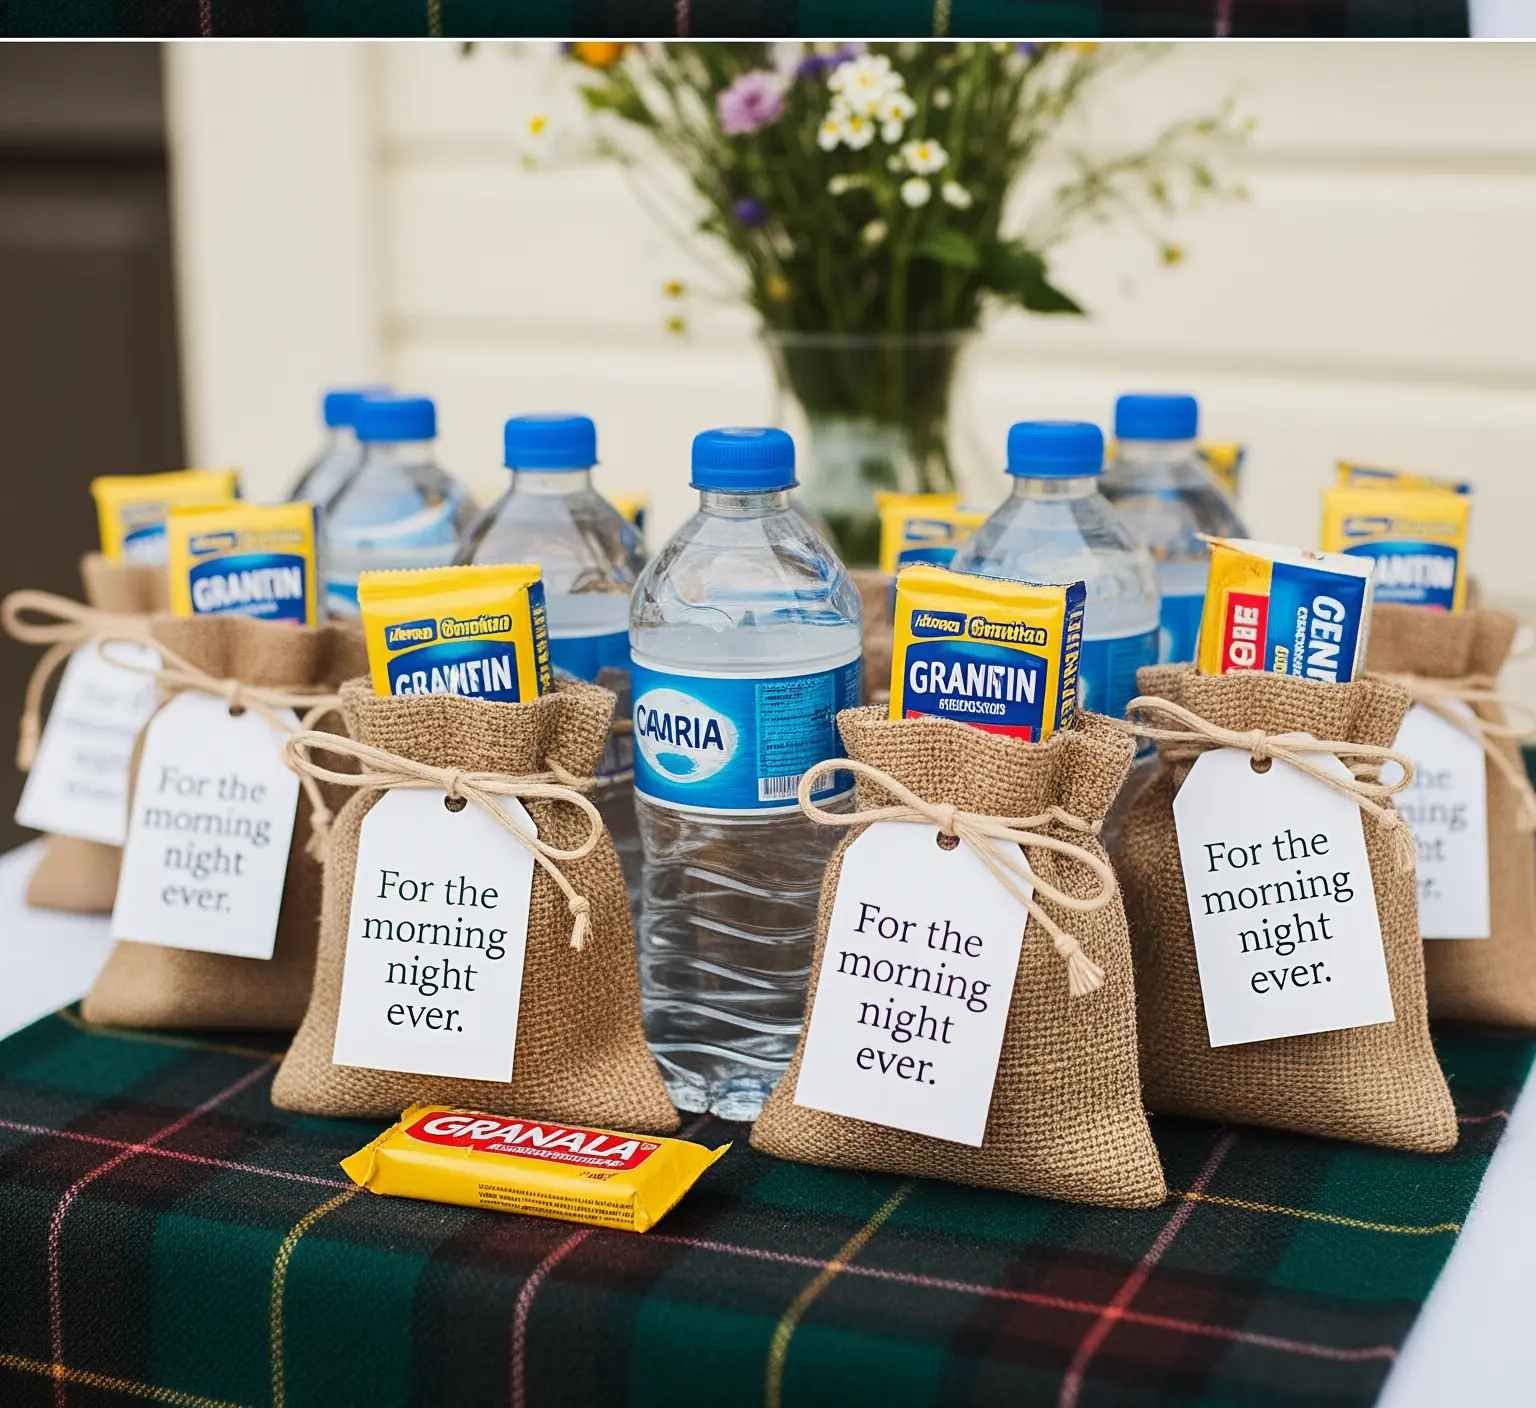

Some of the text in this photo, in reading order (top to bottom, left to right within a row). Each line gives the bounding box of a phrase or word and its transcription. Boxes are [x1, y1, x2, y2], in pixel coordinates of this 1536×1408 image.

[158, 766, 266, 804] For the
[144, 806, 272, 848] morning
[164, 846, 244, 879] night
[1203, 829, 1330, 873] For the
[161, 886, 231, 913] ever.
[376, 869, 499, 910] For the
[1200, 869, 1354, 916] morning
[361, 916, 508, 960] morning
[853, 901, 983, 958] For the
[1237, 912, 1334, 957] night
[384, 954, 479, 997] night
[836, 949, 992, 1013] morning
[1250, 961, 1332, 994] ever.
[386, 1003, 463, 1033] ever.
[856, 997, 955, 1045] night
[856, 1045, 936, 1085] ever.
[422, 1115, 646, 1161] GRANALA
